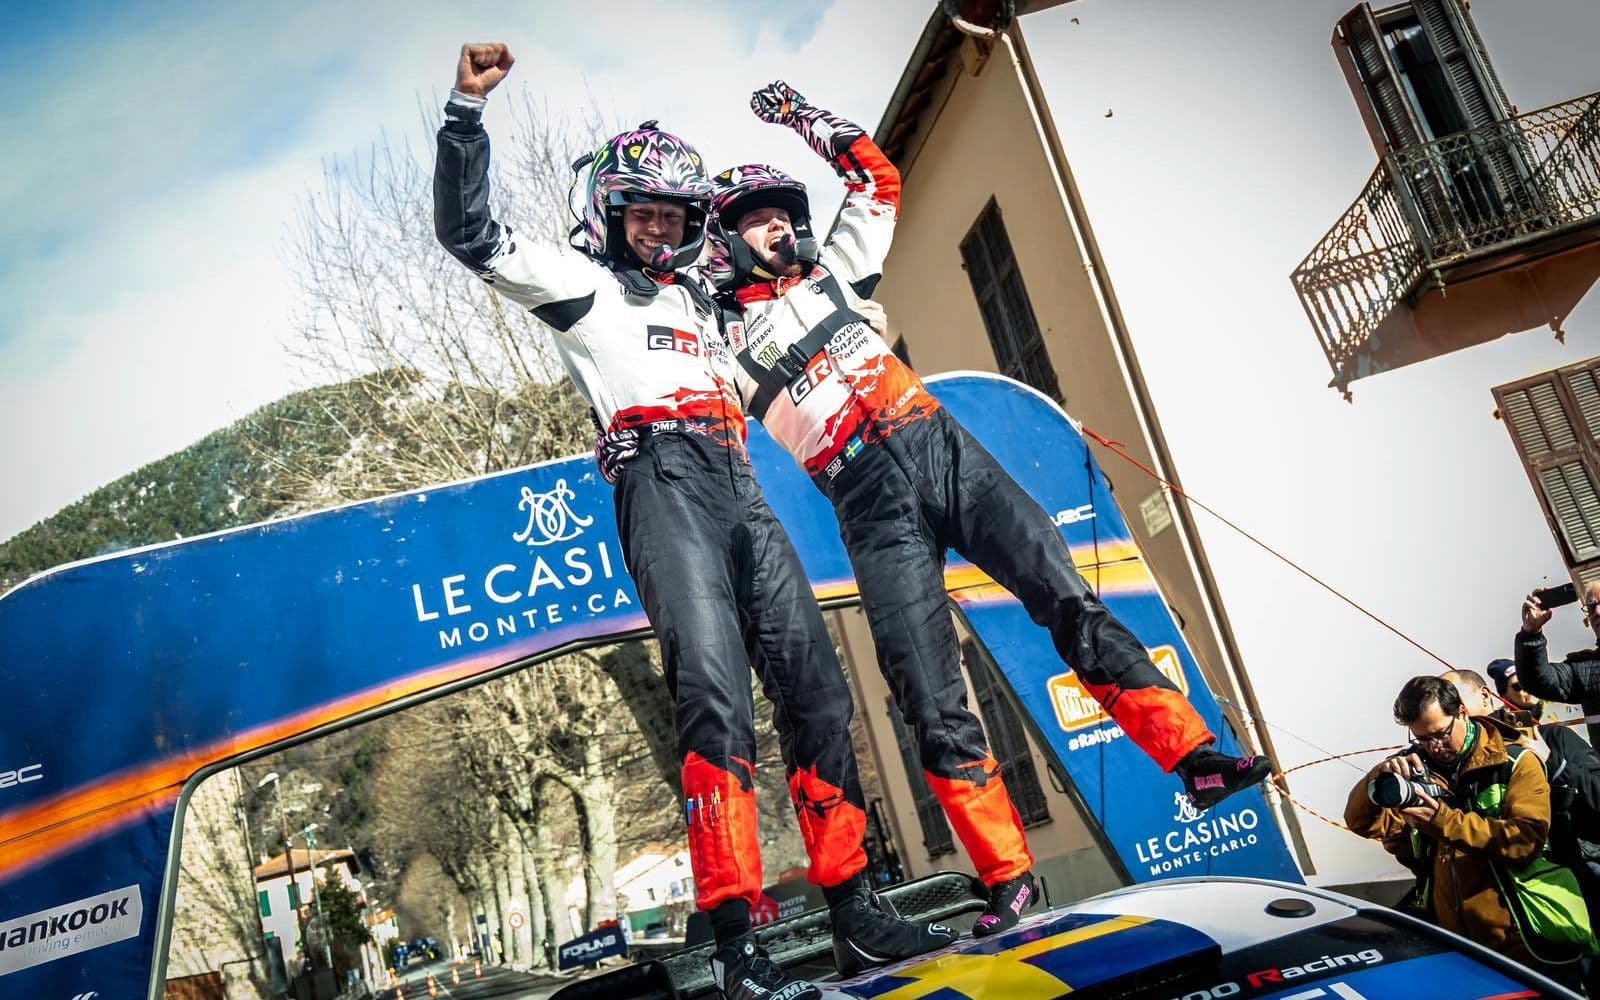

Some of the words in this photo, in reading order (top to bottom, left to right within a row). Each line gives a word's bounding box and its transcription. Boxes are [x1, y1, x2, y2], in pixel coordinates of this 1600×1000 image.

[648, 333, 699, 357] GR
[789, 356, 833, 405] GR
[651, 422, 678, 433] OMP
[826, 458, 842, 477] OMP
[412, 574, 472, 622] LE
[484, 541, 613, 604] CASI
[1135, 837, 1163, 864] LE
[1165, 808, 1258, 853] CASINO
[1247, 948, 1384, 988] Racing
[771, 981, 812, 1000] OMP
